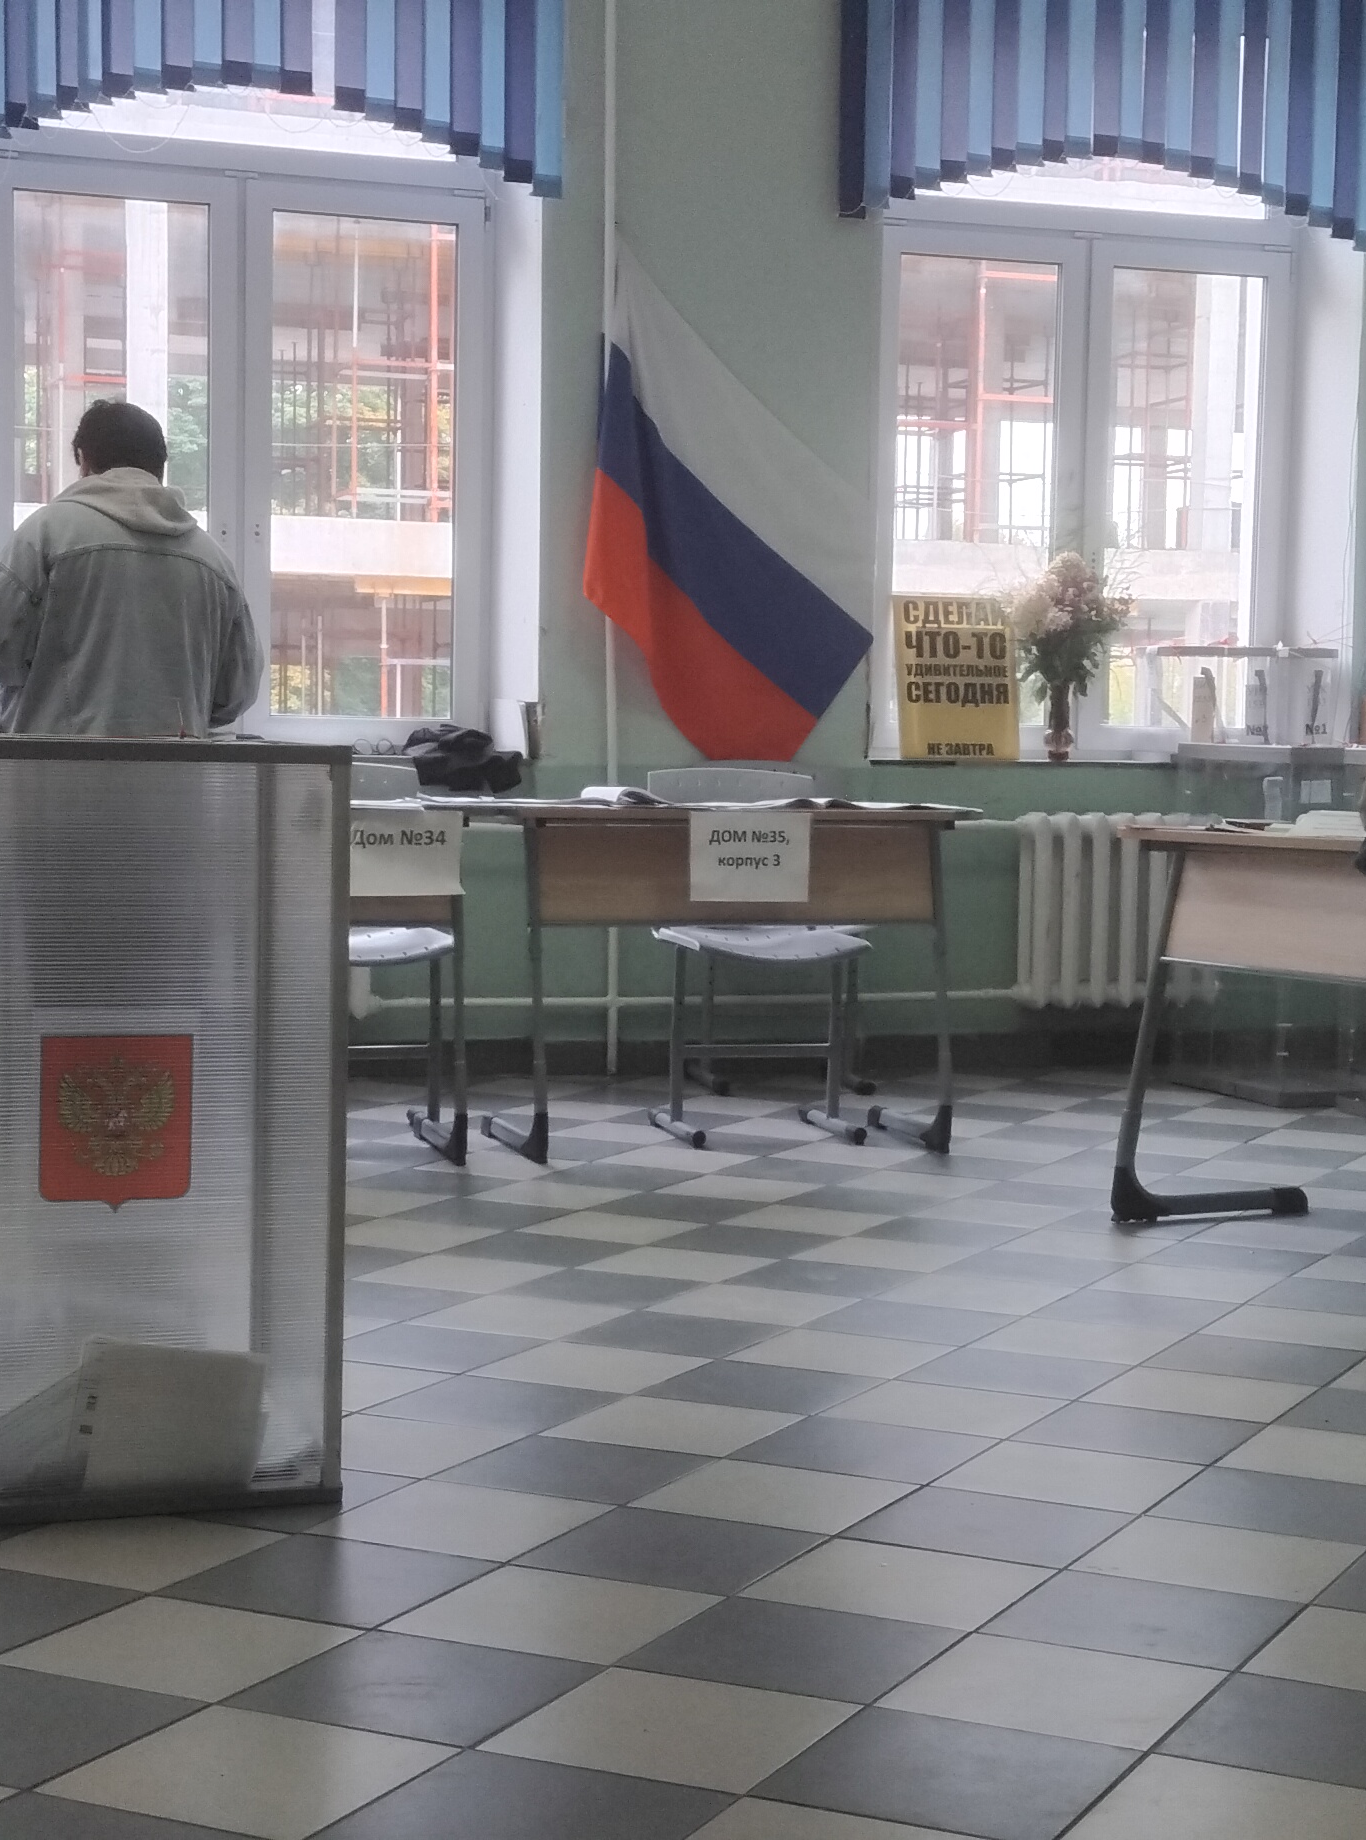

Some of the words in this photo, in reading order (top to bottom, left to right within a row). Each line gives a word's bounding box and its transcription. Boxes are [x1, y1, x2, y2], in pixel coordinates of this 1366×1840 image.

[905, 631, 1007, 660] ЧТО-ТО
[905, 663, 1009, 678] УДИВИТЕЛЬНОЕ
[906, 681, 1010, 708] СЕГОДНЯ
[927, 743, 943, 756] НЕ
[945, 743, 995, 756] ЗАВТРА
[353, 829, 394, 849] Дом
[400, 829, 447, 846] №34
[708, 829, 747, 846] ДОМ
[751, 830, 790, 845] №35,
[717, 857, 768, 870] корпус
[772, 854, 781, 867] 3
